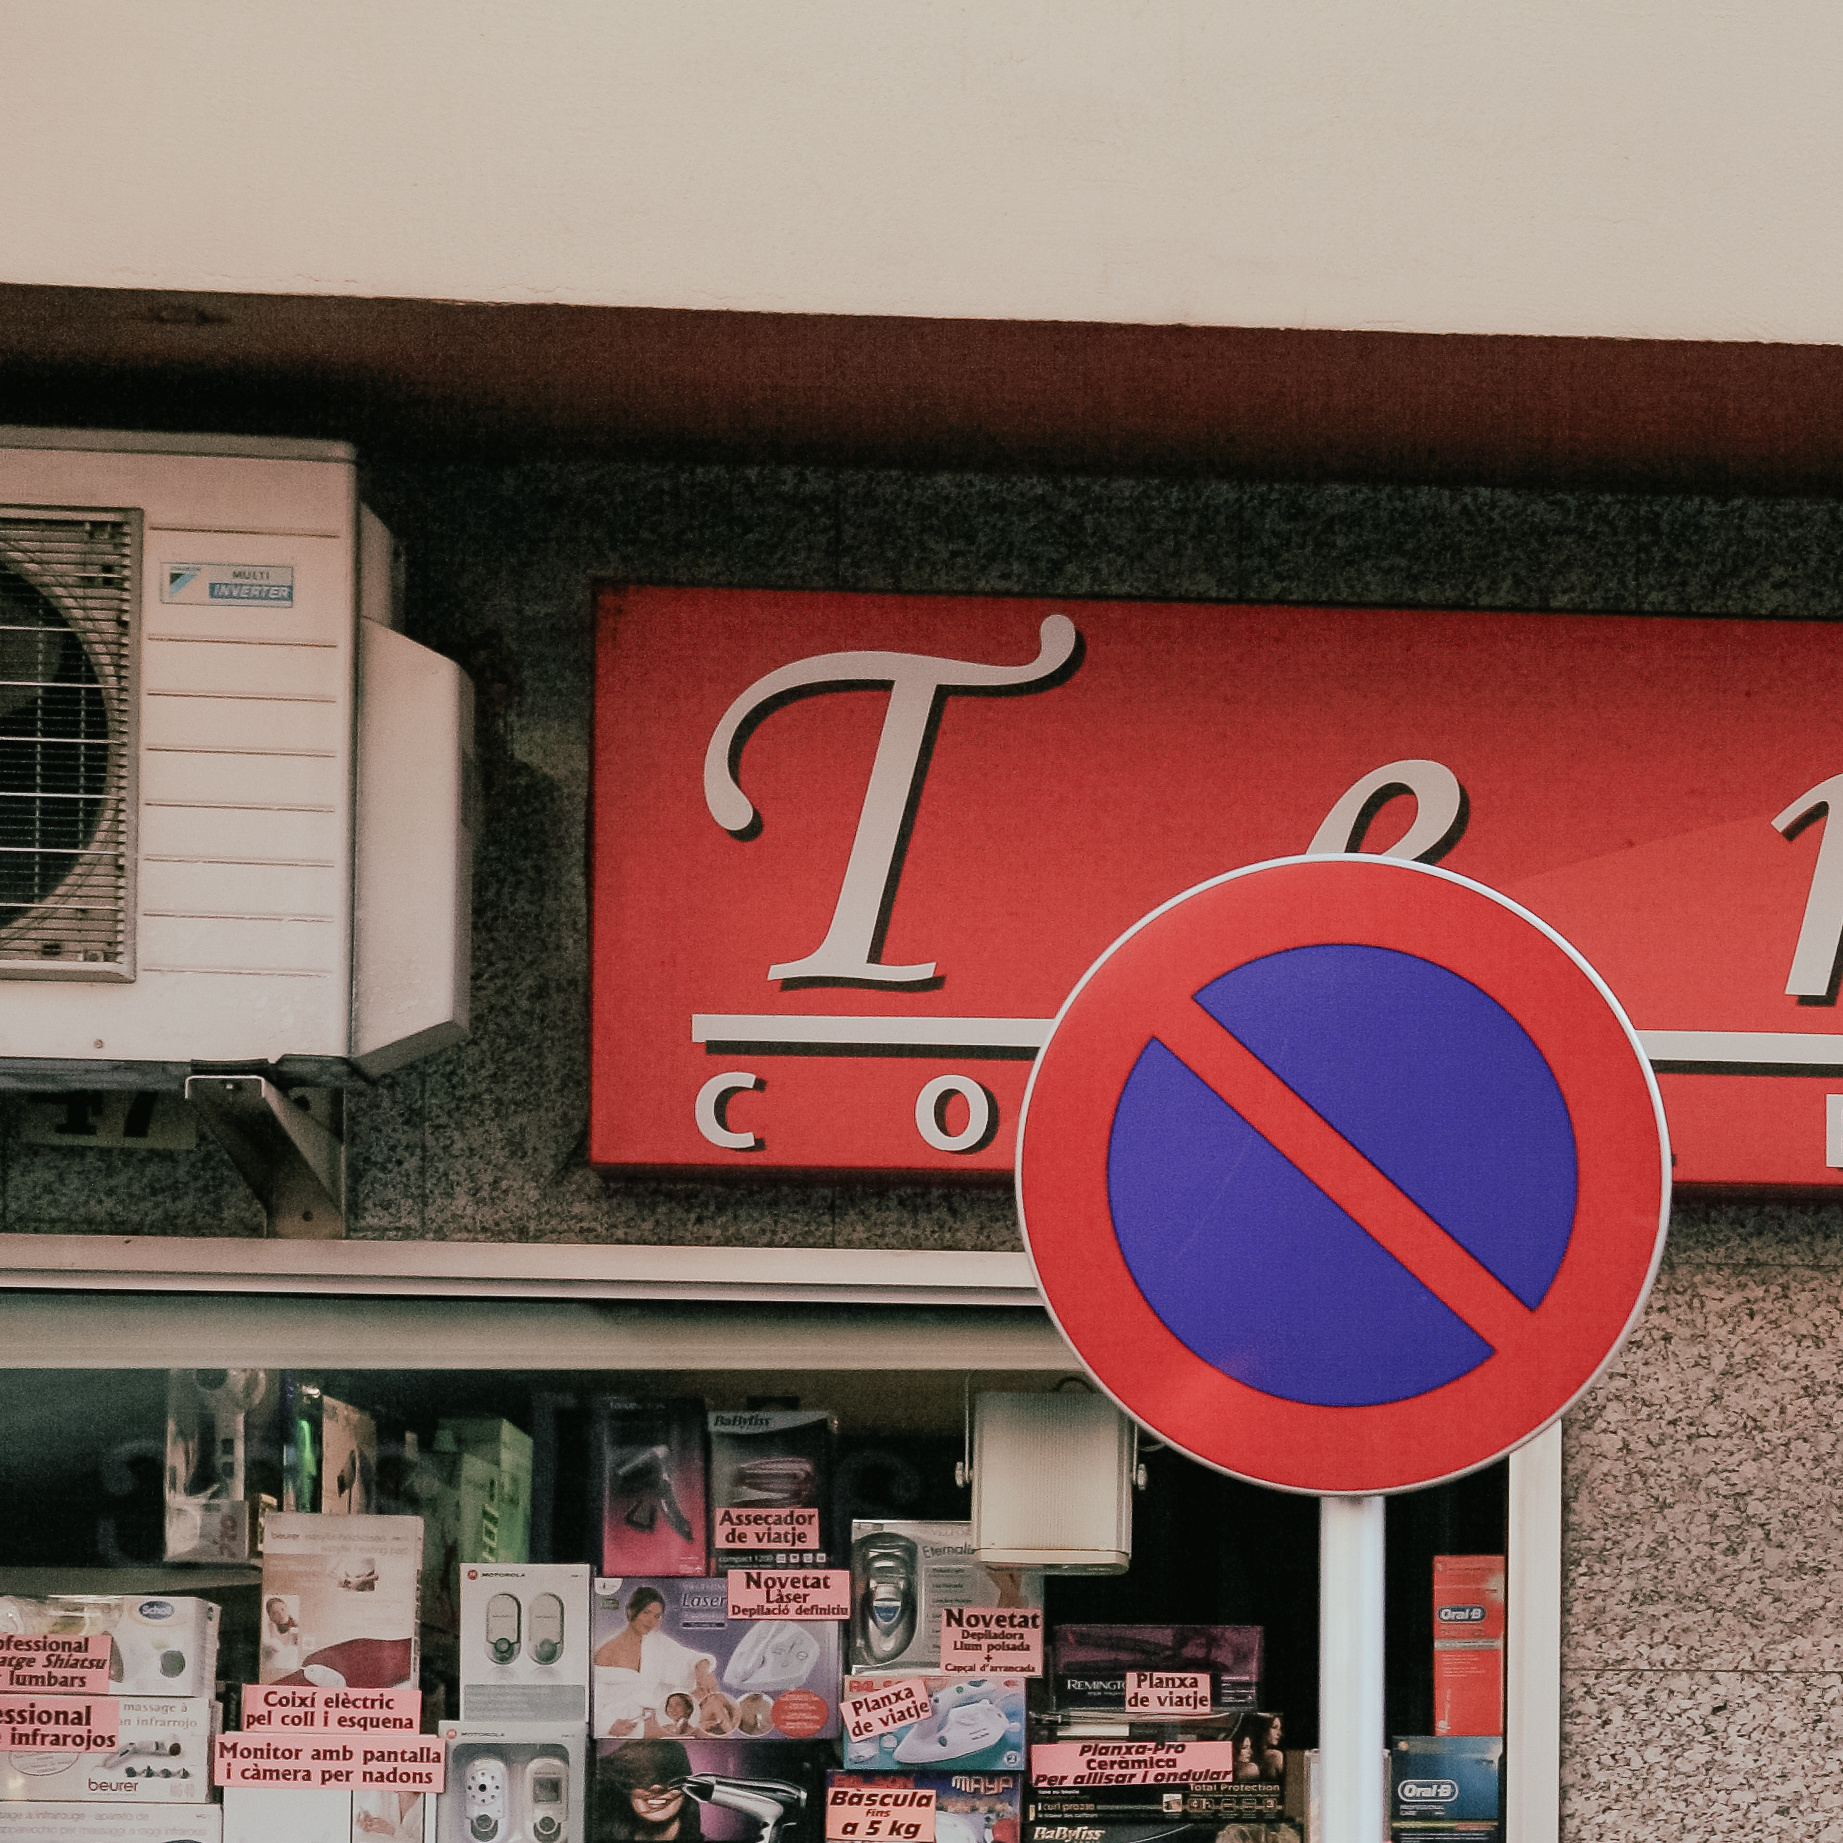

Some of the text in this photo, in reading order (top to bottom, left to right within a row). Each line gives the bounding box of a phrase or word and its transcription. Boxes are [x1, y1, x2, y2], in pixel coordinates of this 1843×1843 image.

[232, 570, 270, 580] MULTI
[214, 585, 290, 599] INVERTER
[720, 1511, 815, 1528] Assecador
[725, 1530, 807, 1547] de viatje
[745, 1572, 831, 1590] Novetat
[945, 1609, 1040, 1628] Novetat
[8, 1673, 86, 1687] lumbars
[1136, 1673, 1199, 1690] Planxa
[852, 1685, 914, 1718] Planxa
[1128, 1692, 1208, 1710] de viatje
[246, 1711, 413, 1730] pel coll i esquena
[851, 1700, 930, 1737] de viatje
[10, 1730, 116, 1750] infrarojos
[219, 1742, 441, 1766] Monitor amb pantalla
[1080, 1742, 1185, 1757] Planxa-Pro
[226, 1764, 433, 1784] i càmera per nadons
[88, 1778, 139, 1792] beurer
[842, 1820, 921, 1839] a 5 kg
